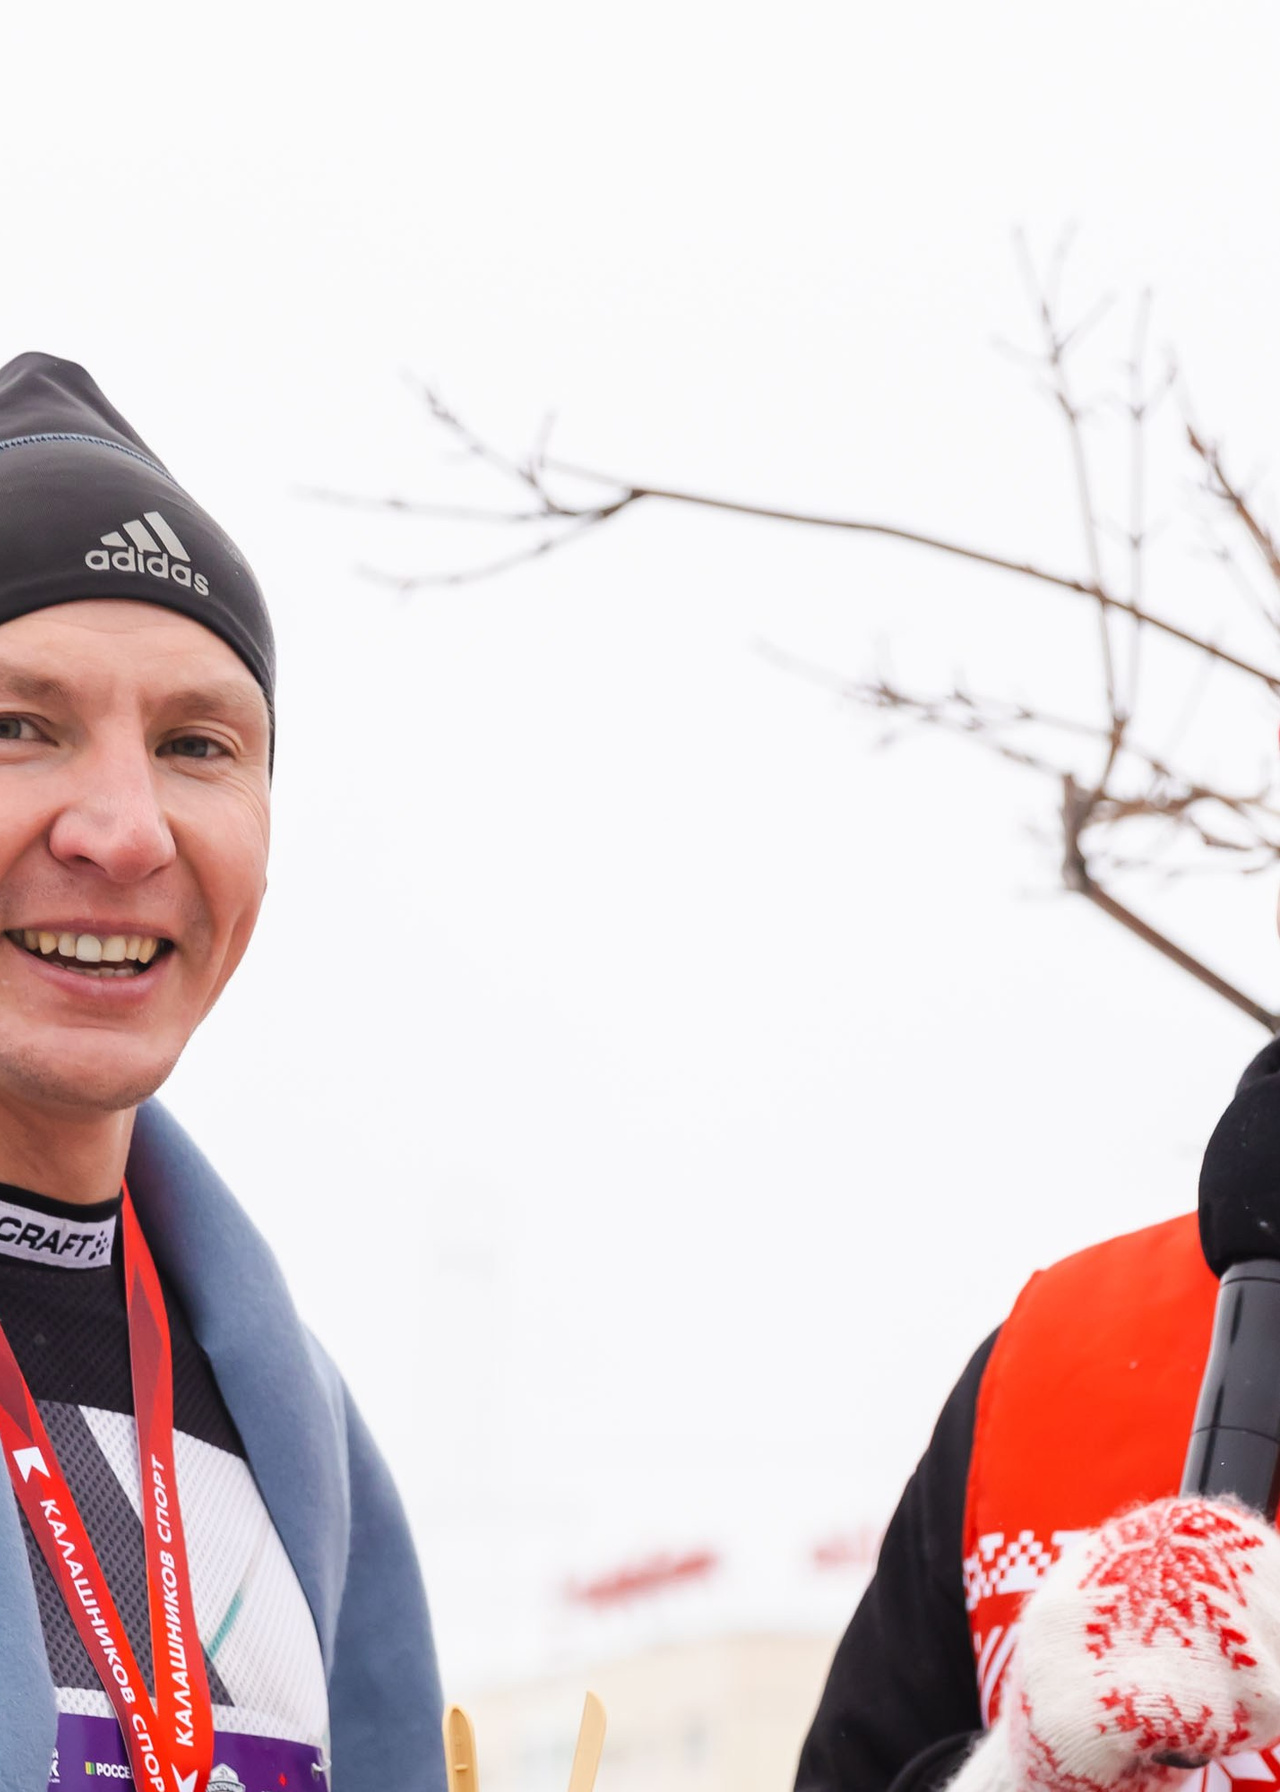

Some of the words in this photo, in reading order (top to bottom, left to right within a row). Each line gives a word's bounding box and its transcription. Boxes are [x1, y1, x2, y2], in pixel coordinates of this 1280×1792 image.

[84, 546, 210, 596] adidas
[150, 1453, 173, 1544] СПОРТ
[40, 1499, 136, 1704] КАЛАШНИКОВ
[159, 1548, 195, 1748] КАЛАШНИКОВ
